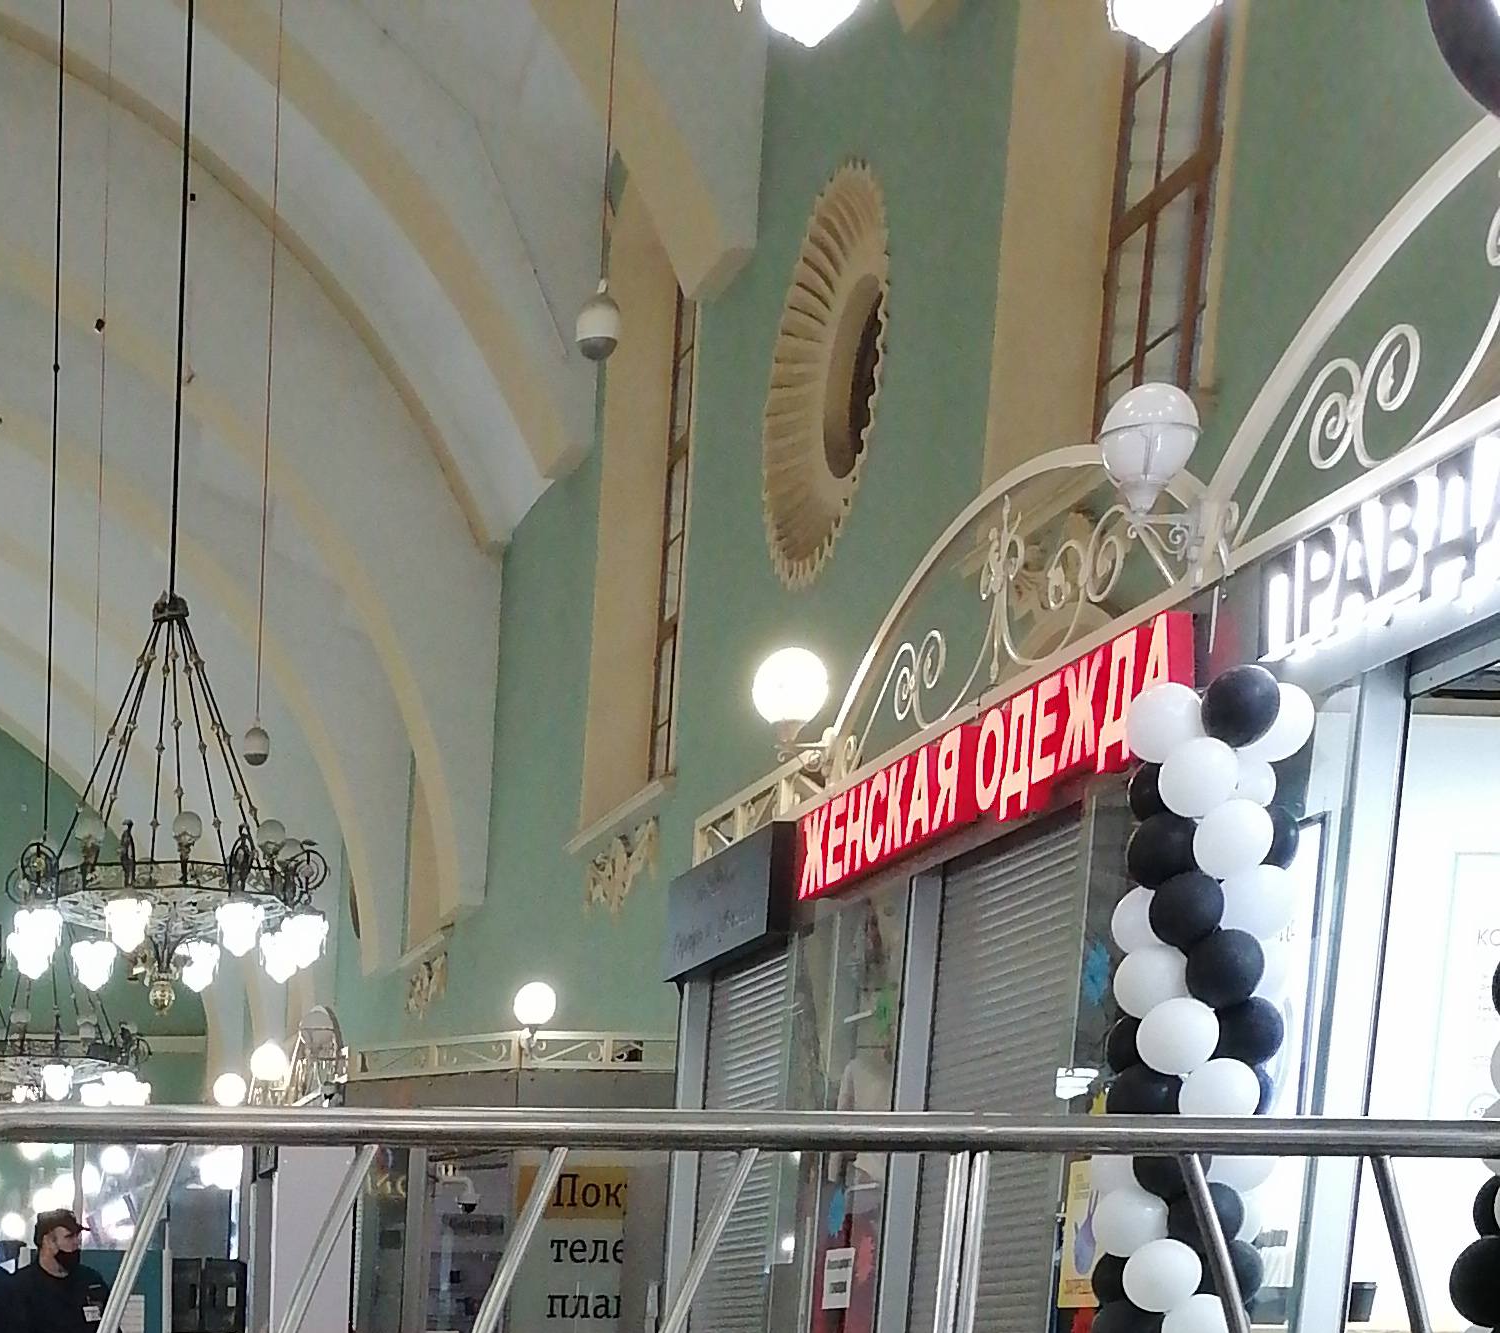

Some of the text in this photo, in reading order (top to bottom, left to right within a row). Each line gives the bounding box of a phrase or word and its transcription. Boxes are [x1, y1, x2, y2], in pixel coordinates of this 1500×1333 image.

[1257, 446, 1500, 657] ПРАВД
[799, 613, 1170, 900] ЖЕНСКАЯ ОДЕЖДА
[552, 1173, 628, 1214] Пок
